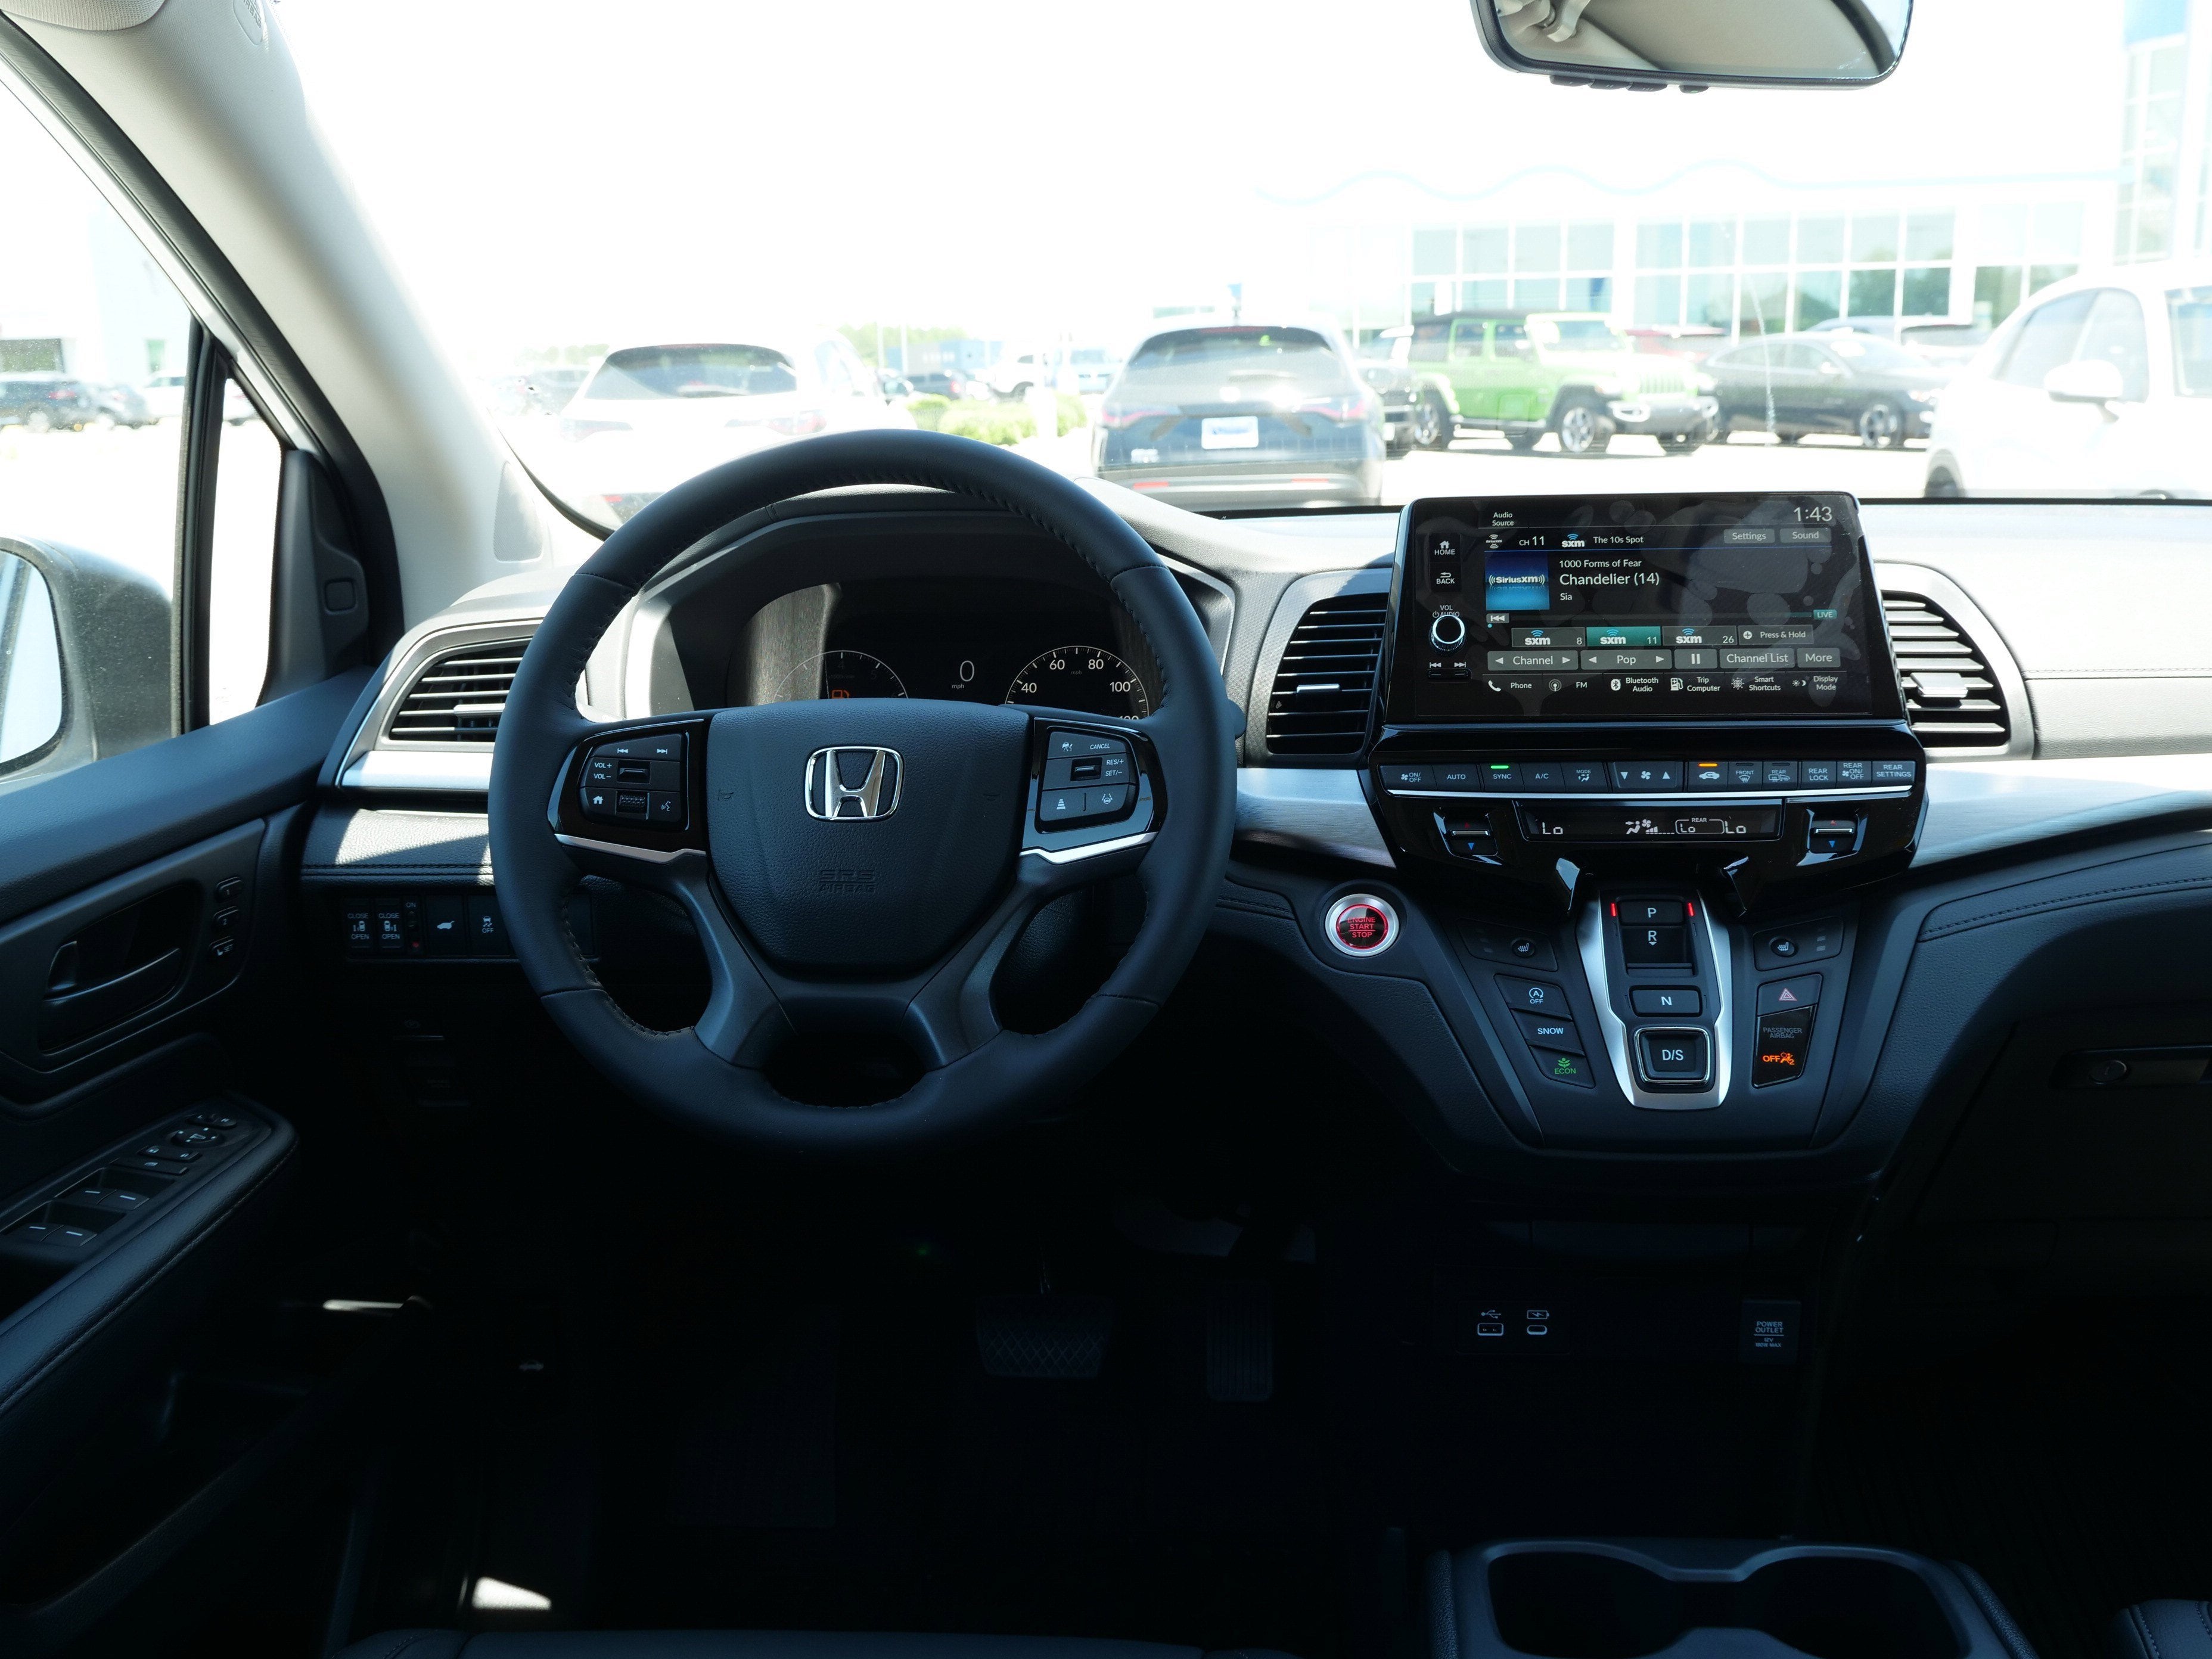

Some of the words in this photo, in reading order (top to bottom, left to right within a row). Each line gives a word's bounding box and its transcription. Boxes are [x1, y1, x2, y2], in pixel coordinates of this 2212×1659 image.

[1793, 507, 1832, 521] 1:43
[1732, 532, 1767, 541] Settings
[1792, 531, 1819, 539] Sound
[1532, 536, 1545, 546] 11
[1626, 536, 1644, 545] Spot
[1611, 559, 1621, 567] of
[1623, 559, 1642, 567] Fear
[1559, 573, 1630, 585] Chandelier
[1634, 573, 1660, 586] (14)
[1513, 656, 1554, 665] Channel
[1617, 655, 1636, 666] Pop
[1726, 654, 1767, 663] Channel
[1770, 654, 1789, 663] List
[1806, 654, 1833, 662] More
[1049, 660, 1065, 670] 60
[1088, 659, 1104, 669] 80
[959, 660, 975, 682] 0
[1697, 676, 1709, 685] Trip
[1813, 675, 1838, 684] Display
[1021, 683, 1037, 693] 40
[1110, 681, 1131, 692] 100
[1647, 908, 1657, 918] P
[1648, 930, 1657, 941] R
[1661, 996, 1672, 1006] N
[1662, 1049, 1683, 1061] D/S
